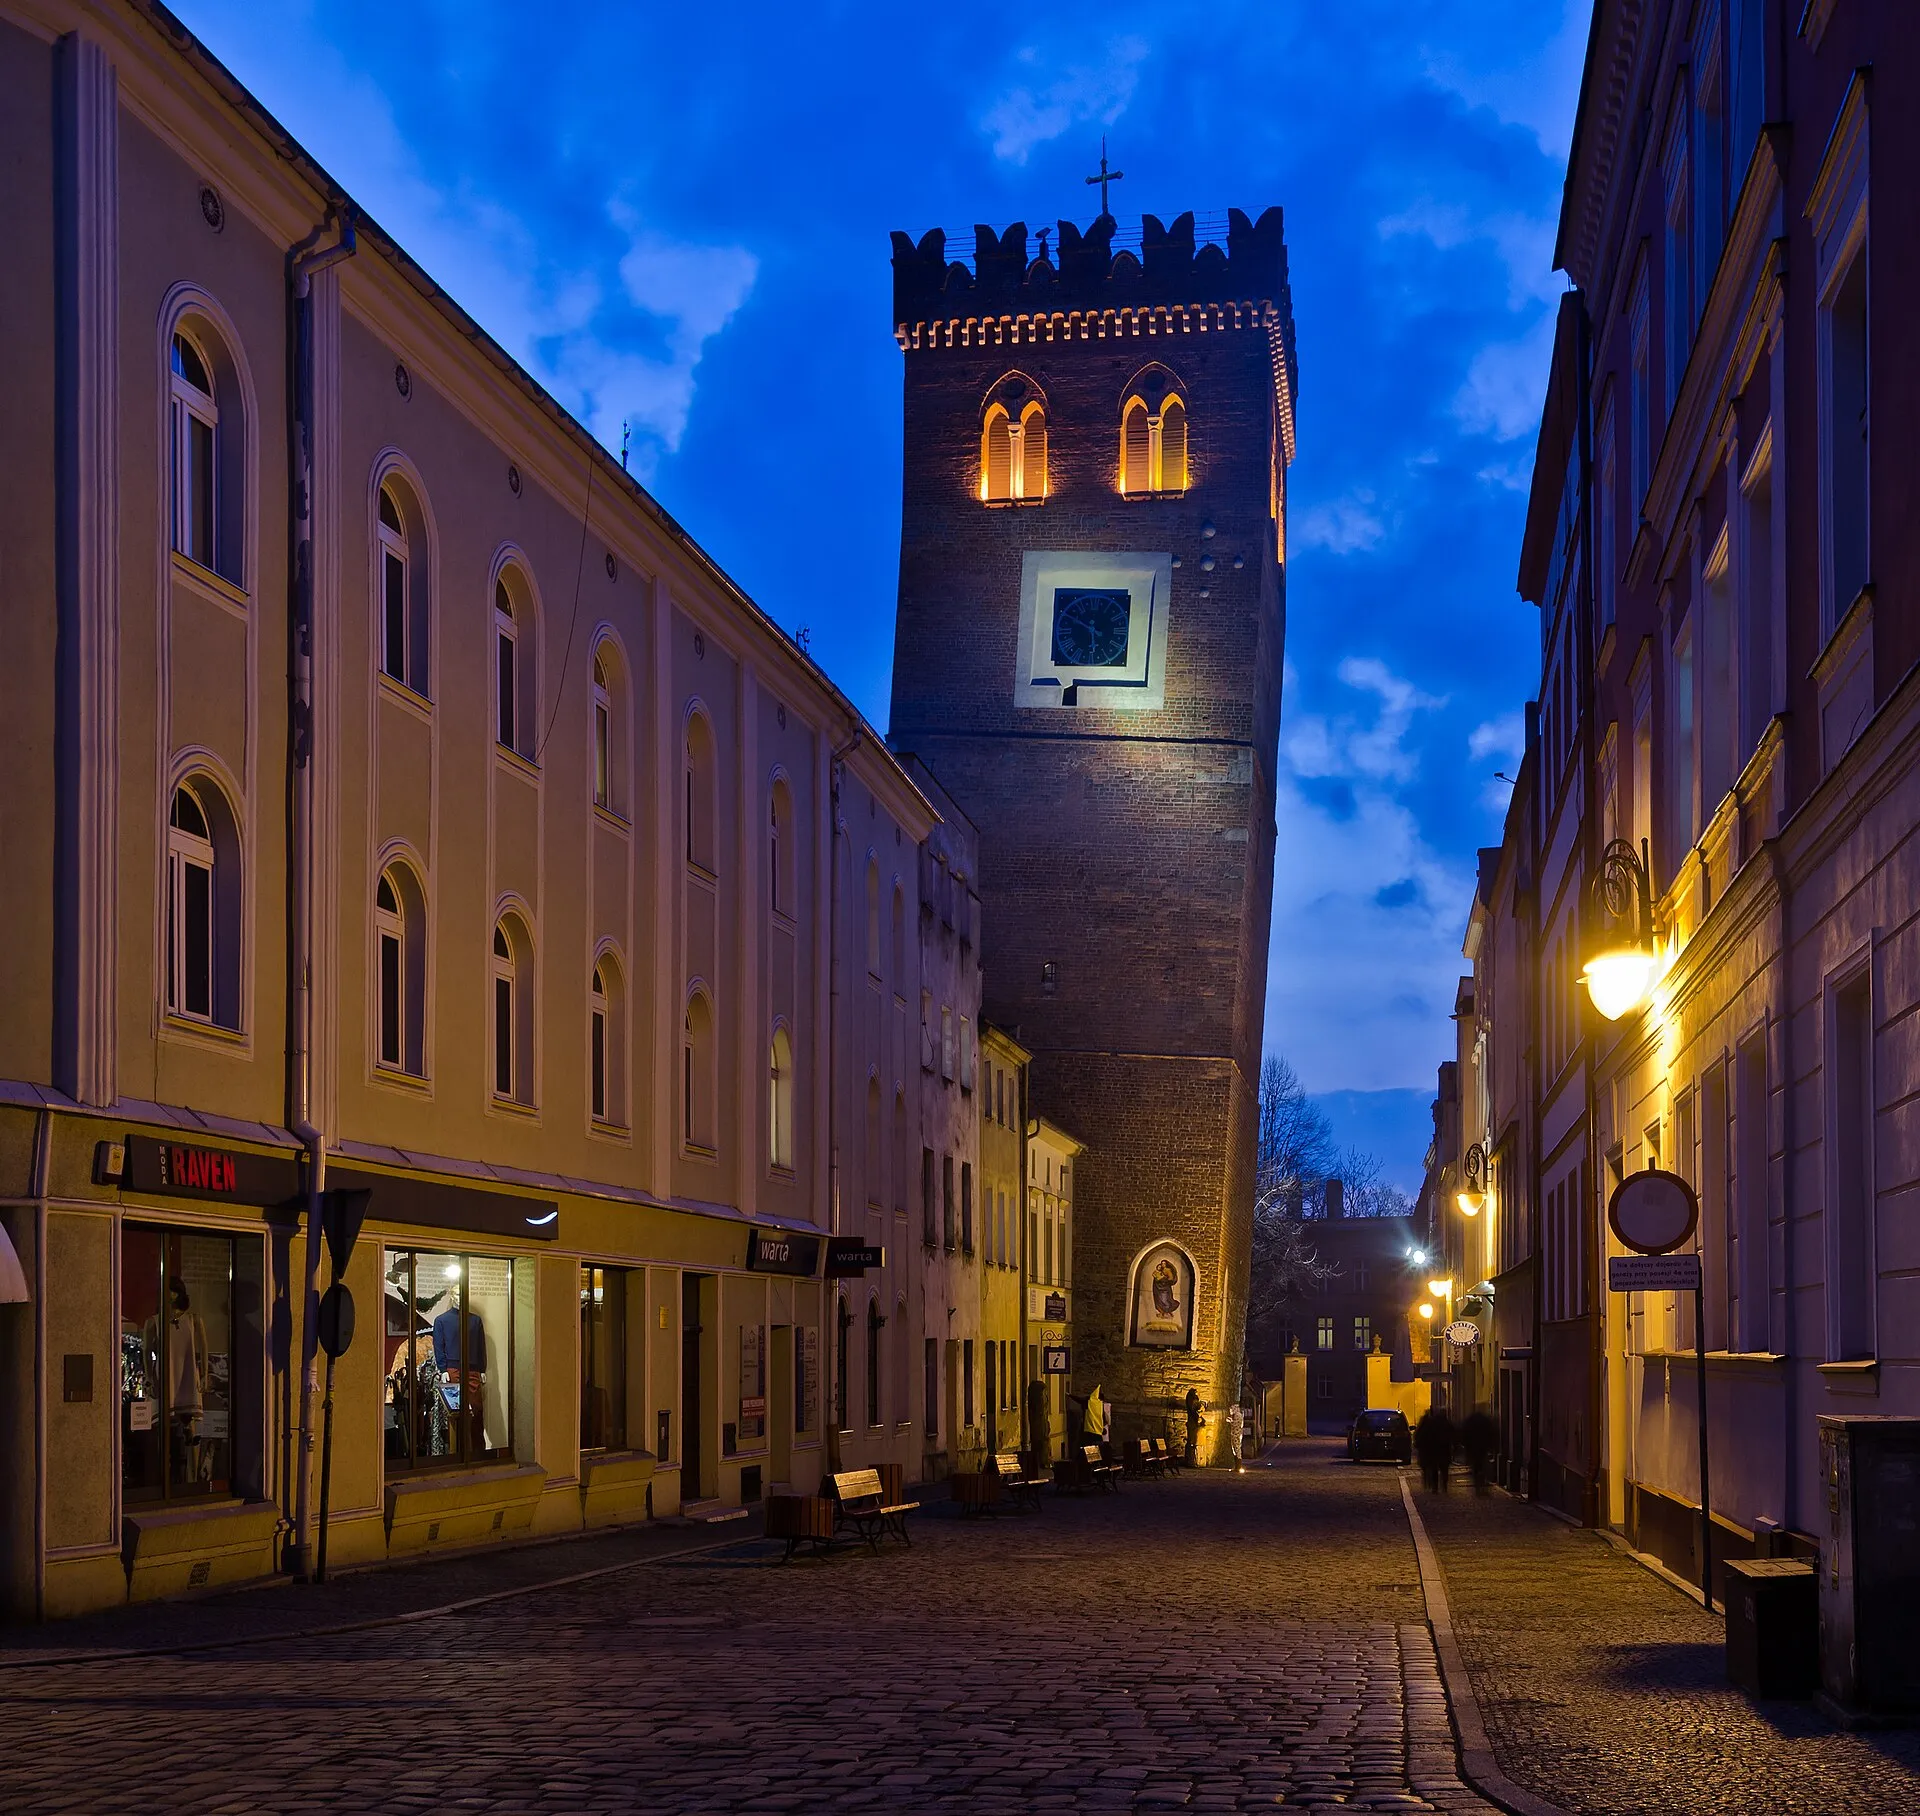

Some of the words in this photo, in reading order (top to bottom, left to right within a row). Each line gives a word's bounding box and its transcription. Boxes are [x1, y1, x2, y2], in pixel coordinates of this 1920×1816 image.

[159, 1145, 168, 1185] MODA
[171, 1147, 236, 1192] RAVEN
[760, 1240, 789, 1262] warta
[837, 1251, 873, 1262] warta
[1649, 1270, 1672, 1278] posesji
